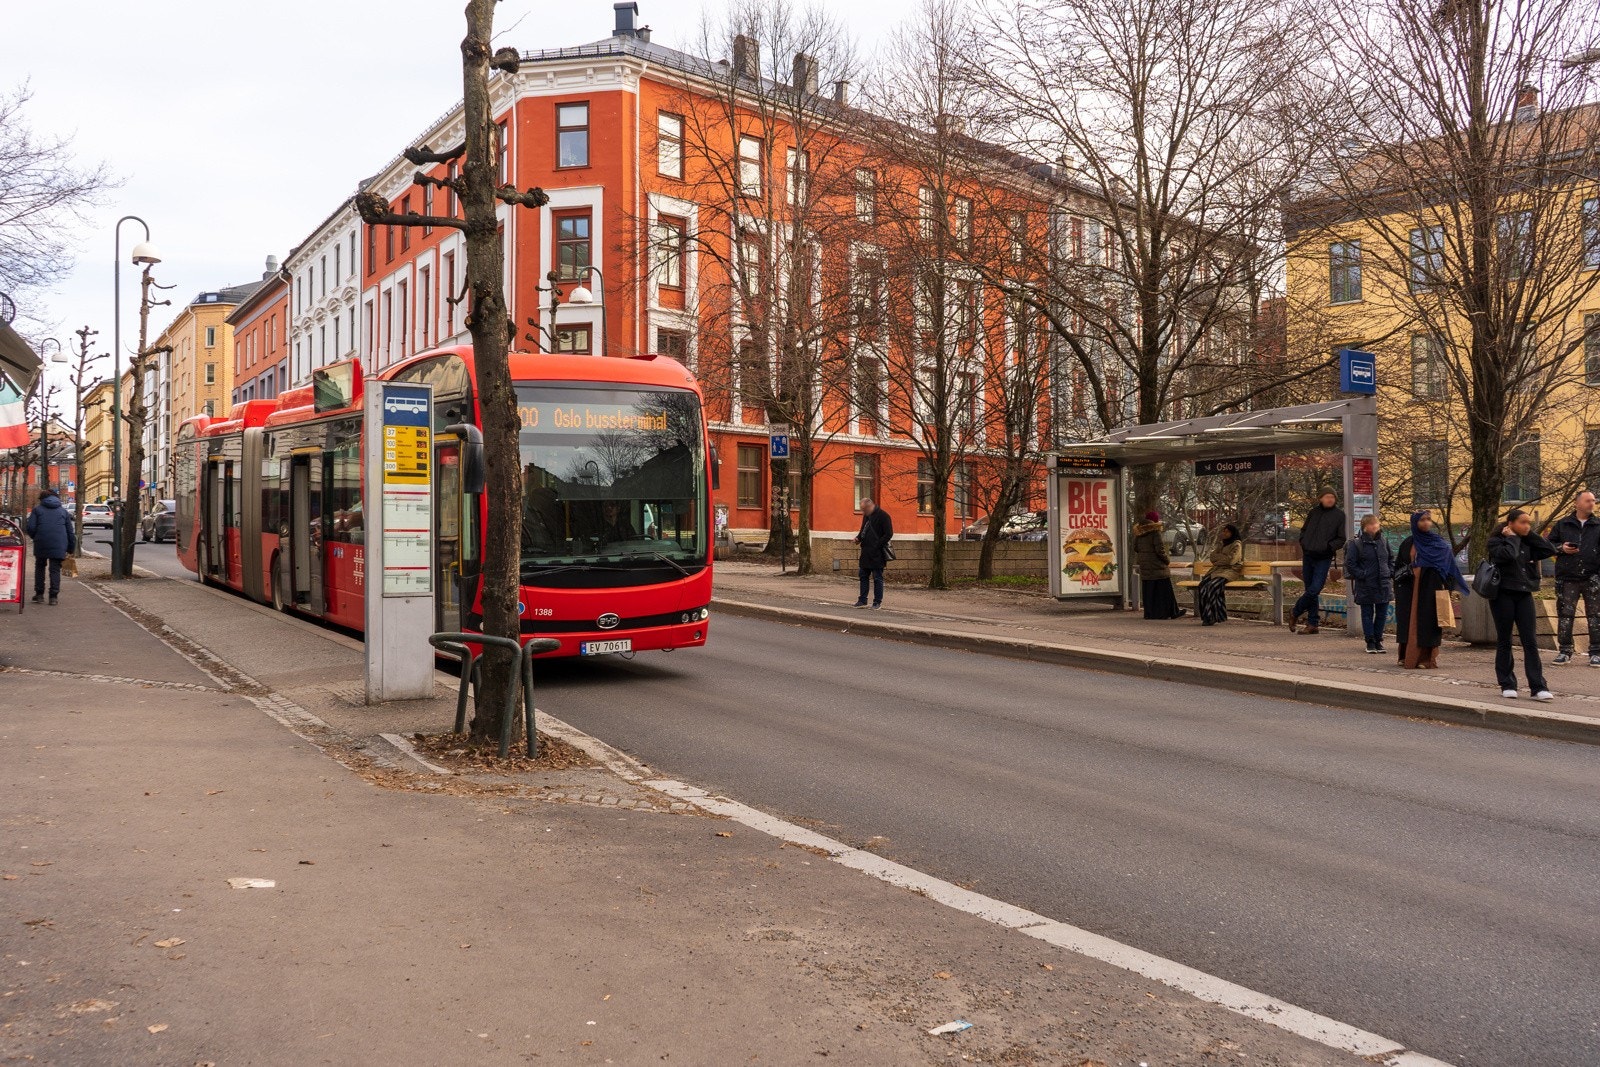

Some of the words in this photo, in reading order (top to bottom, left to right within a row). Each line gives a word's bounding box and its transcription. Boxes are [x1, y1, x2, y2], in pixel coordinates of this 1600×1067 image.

[517, 407, 539, 427] 00
[554, 408, 581, 428] Oslo
[585, 409, 667, 430] bussterminal
[1216, 462, 1233, 472] Oslo
[1234, 461, 1252, 472] gate
[1068, 481, 1108, 515] BIG
[1068, 515, 1108, 530] CLASSIC
[1081, 570, 1100, 587] MAX
[534, 608, 553, 616] 1388
[599, 617, 618, 625] BYD
[589, 643, 601, 652] EV
[604, 641, 628, 652] 70611
